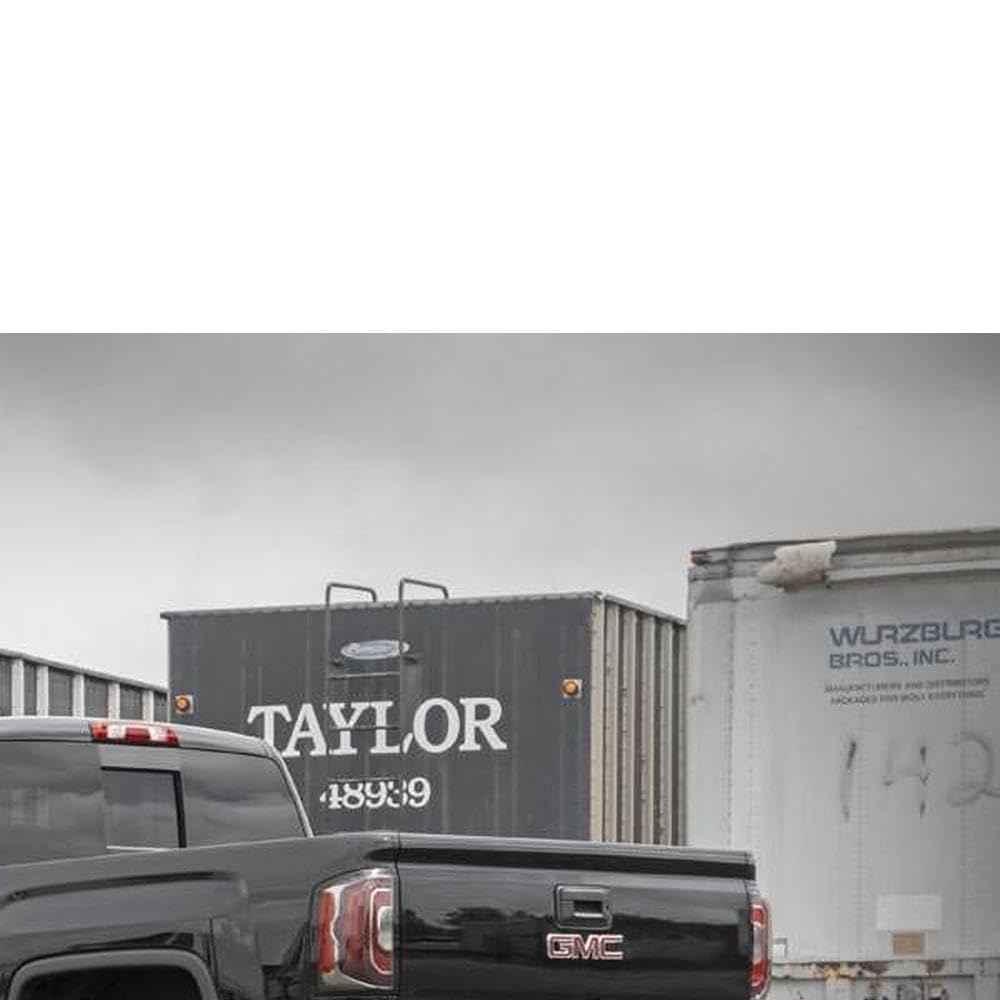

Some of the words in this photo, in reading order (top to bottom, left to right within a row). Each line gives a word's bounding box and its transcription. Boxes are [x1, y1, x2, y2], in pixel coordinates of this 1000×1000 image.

[829, 618, 1000, 647] WURZBURG
[913, 648, 956, 667] INC.
[247, 697, 507, 758] TAYLOR
[319, 777, 431, 809] 48939
[546, 933, 624, 959] GMC
